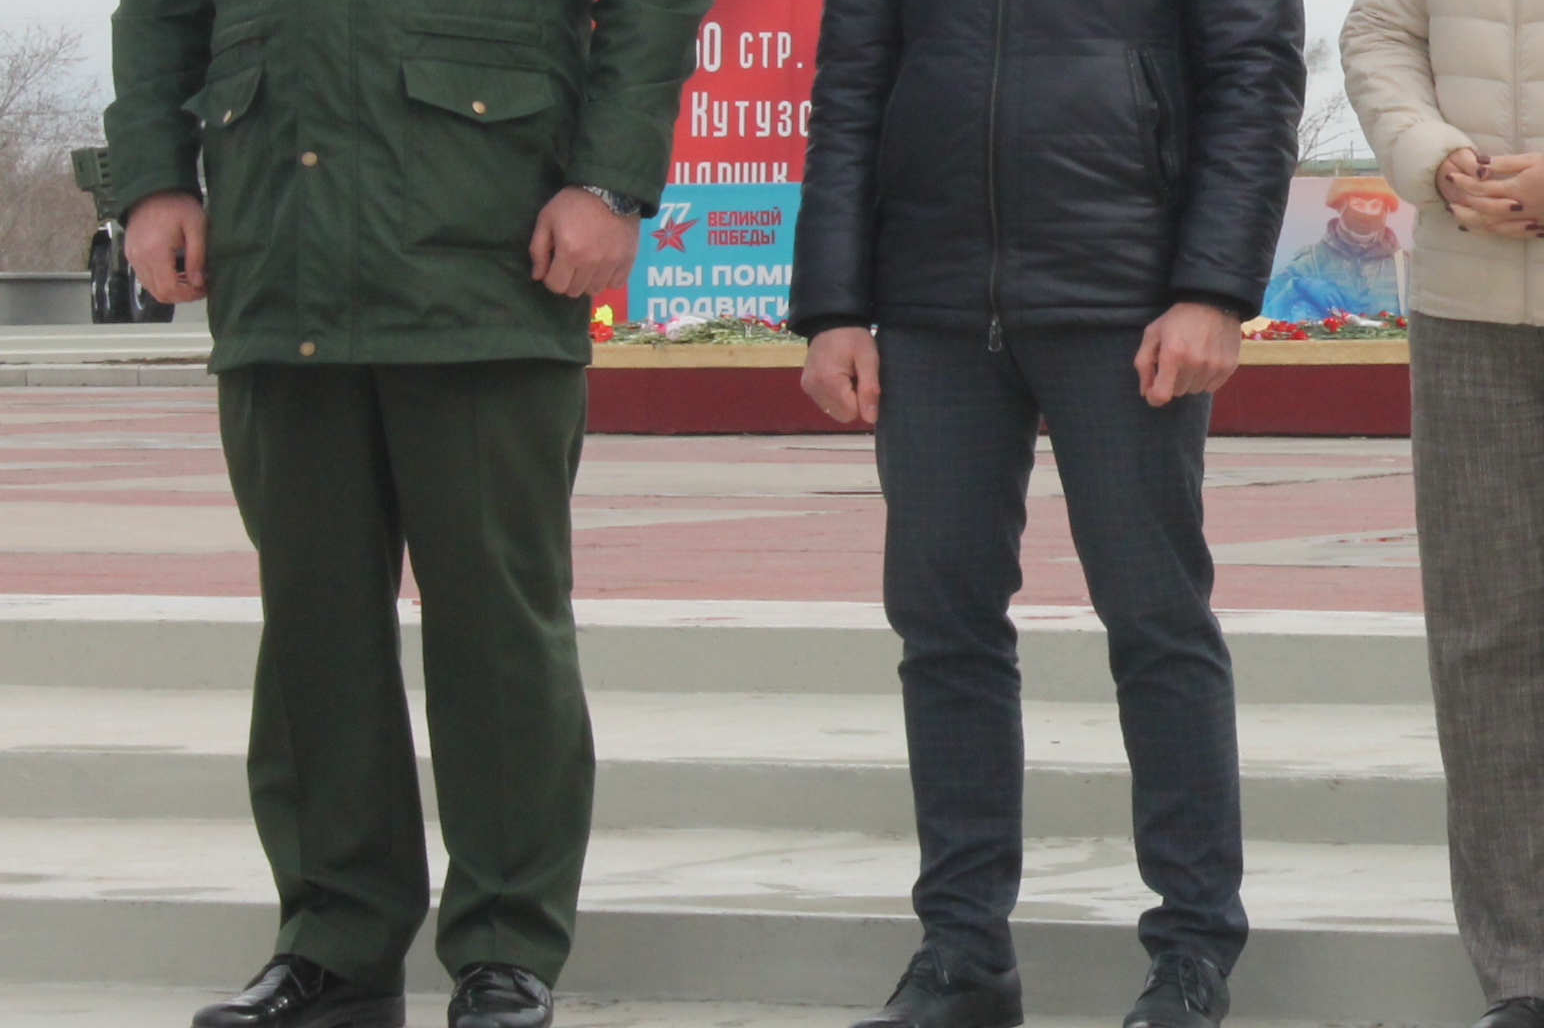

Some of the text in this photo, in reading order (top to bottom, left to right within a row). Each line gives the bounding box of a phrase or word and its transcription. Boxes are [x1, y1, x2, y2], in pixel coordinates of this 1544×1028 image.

[696, 21, 722, 73] 0
[659, 202, 692, 229] 77
[707, 207, 782, 227] ВЕЛИКОЙ
[707, 230, 776, 247] ПОБЕДЫ
[647, 265, 703, 287] МЫ
